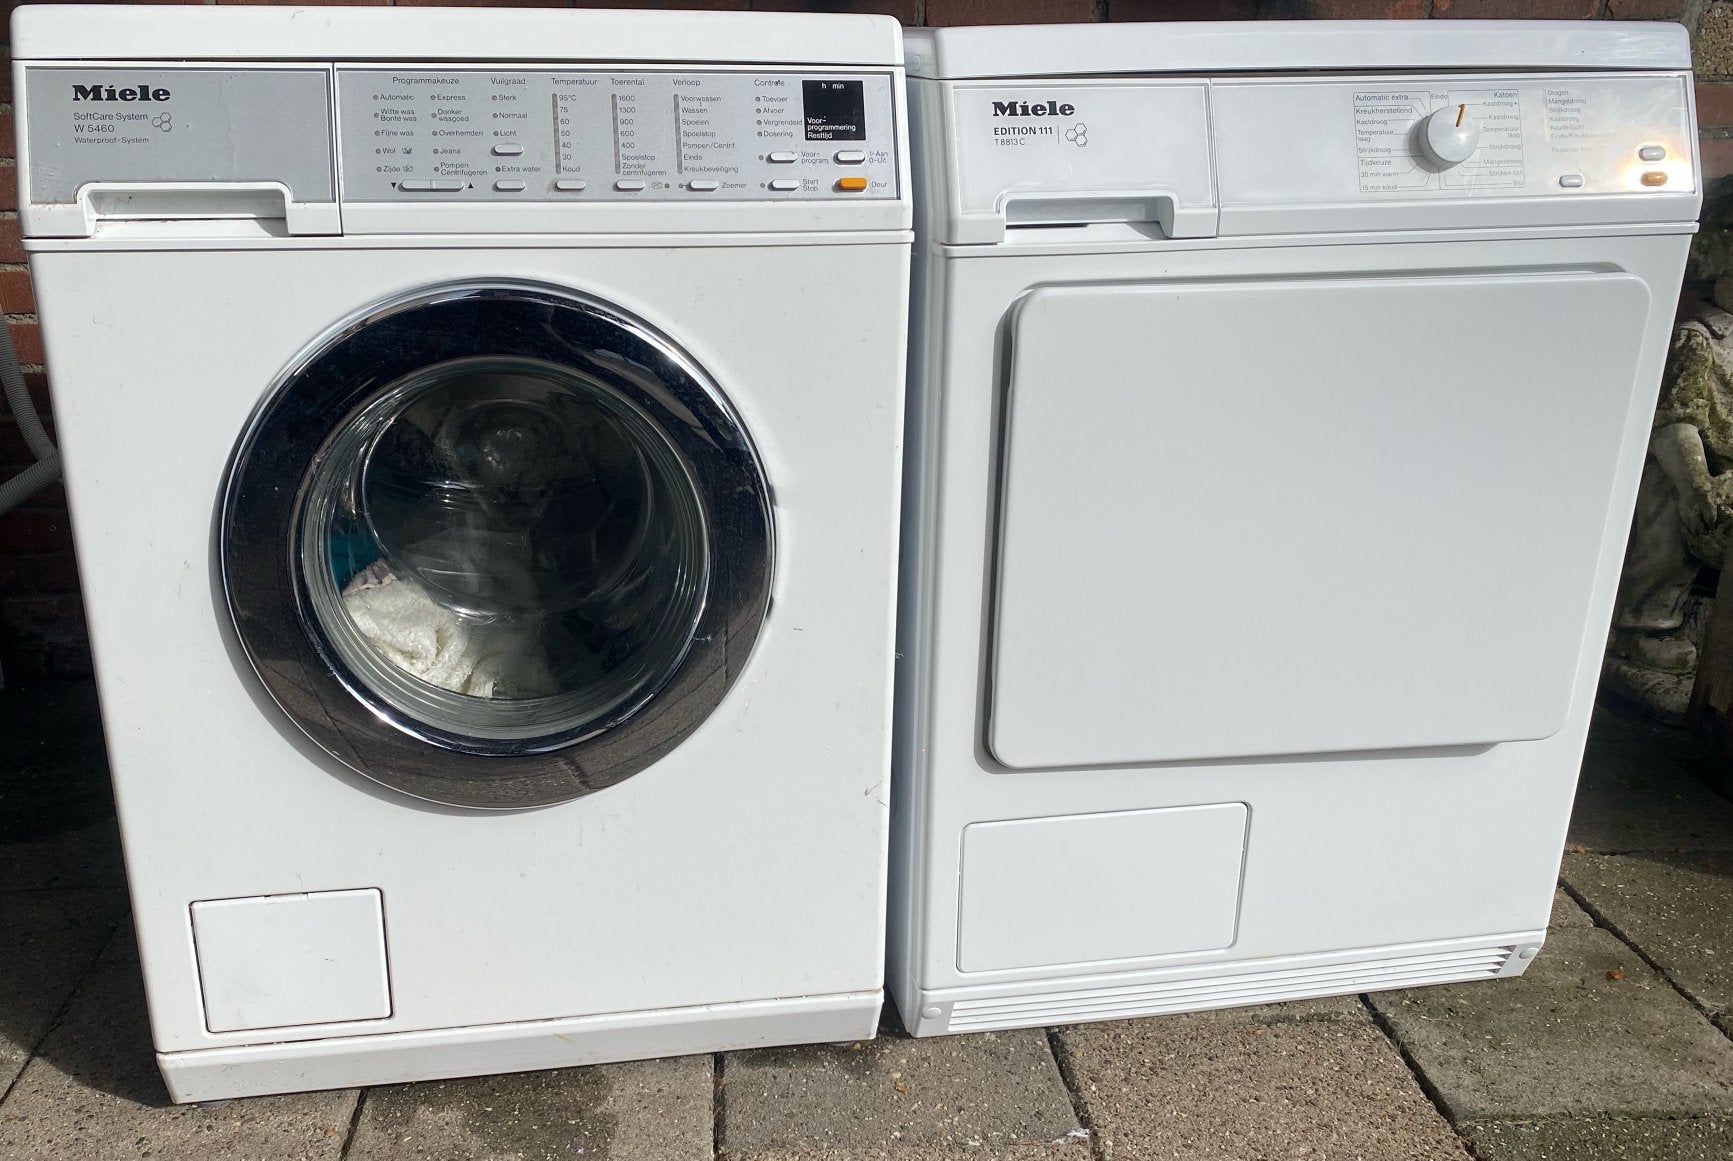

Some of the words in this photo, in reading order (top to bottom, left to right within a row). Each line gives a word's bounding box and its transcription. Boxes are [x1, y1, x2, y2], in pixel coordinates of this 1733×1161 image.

[392, 77, 459, 86] Programmakeuze
[491, 78, 526, 86] Vuilgraad
[72, 85, 171, 102] Miele
[992, 101, 1075, 116] Miele
[74, 112, 113, 121] SoftCare
[116, 113, 148, 121] System
[994, 127, 1036, 135] EDITION
